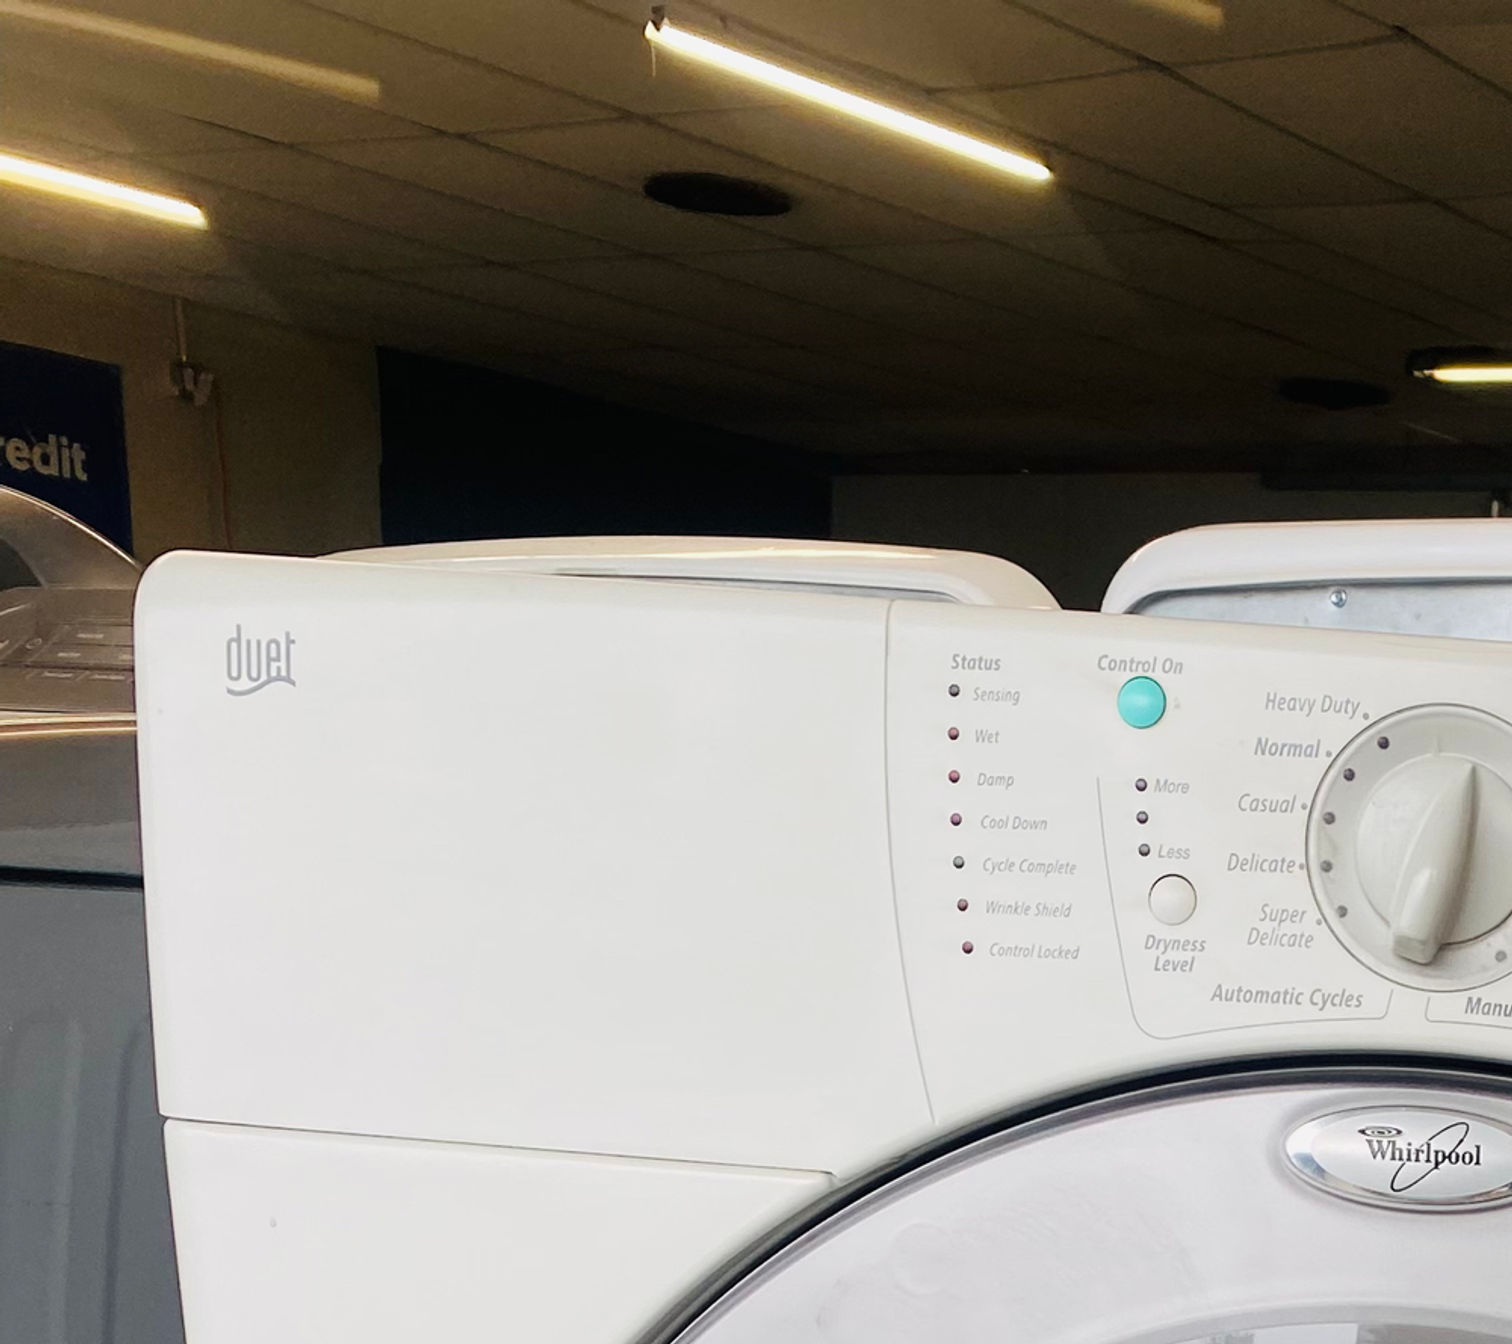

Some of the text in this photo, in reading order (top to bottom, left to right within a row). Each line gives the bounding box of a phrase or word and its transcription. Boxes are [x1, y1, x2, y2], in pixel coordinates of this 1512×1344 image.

[0, 433, 88, 482] edit
[226, 623, 296, 696] duet
[951, 654, 1001, 671] Status
[1098, 655, 1183, 674] Control On
[973, 687, 1020, 705] Sensing
[1265, 692, 1360, 719] Heavy Duty
[975, 729, 999, 744] Wet
[1254, 737, 1320, 758] Normal
[977, 773, 1014, 790] Damp
[1154, 778, 1189, 794] More
[1238, 793, 1296, 813] Casual
[981, 815, 1047, 831] Cool Down
[1158, 844, 1190, 860] Less
[982, 858, 1076, 878] Cycle Complete
[1227, 853, 1296, 873] Delicate
[986, 900, 1072, 918] Wrinkle Shield
[1259, 903, 1306, 925] Super
[1144, 934, 1206, 956] Dryness
[1247, 928, 1314, 949] Delicate
[989, 942, 1079, 959] Control Locked
[1154, 956, 1194, 972] Level
[1211, 984, 1362, 1011] Automatic Cycles
[1366, 1139, 1482, 1170] Whirlpool
